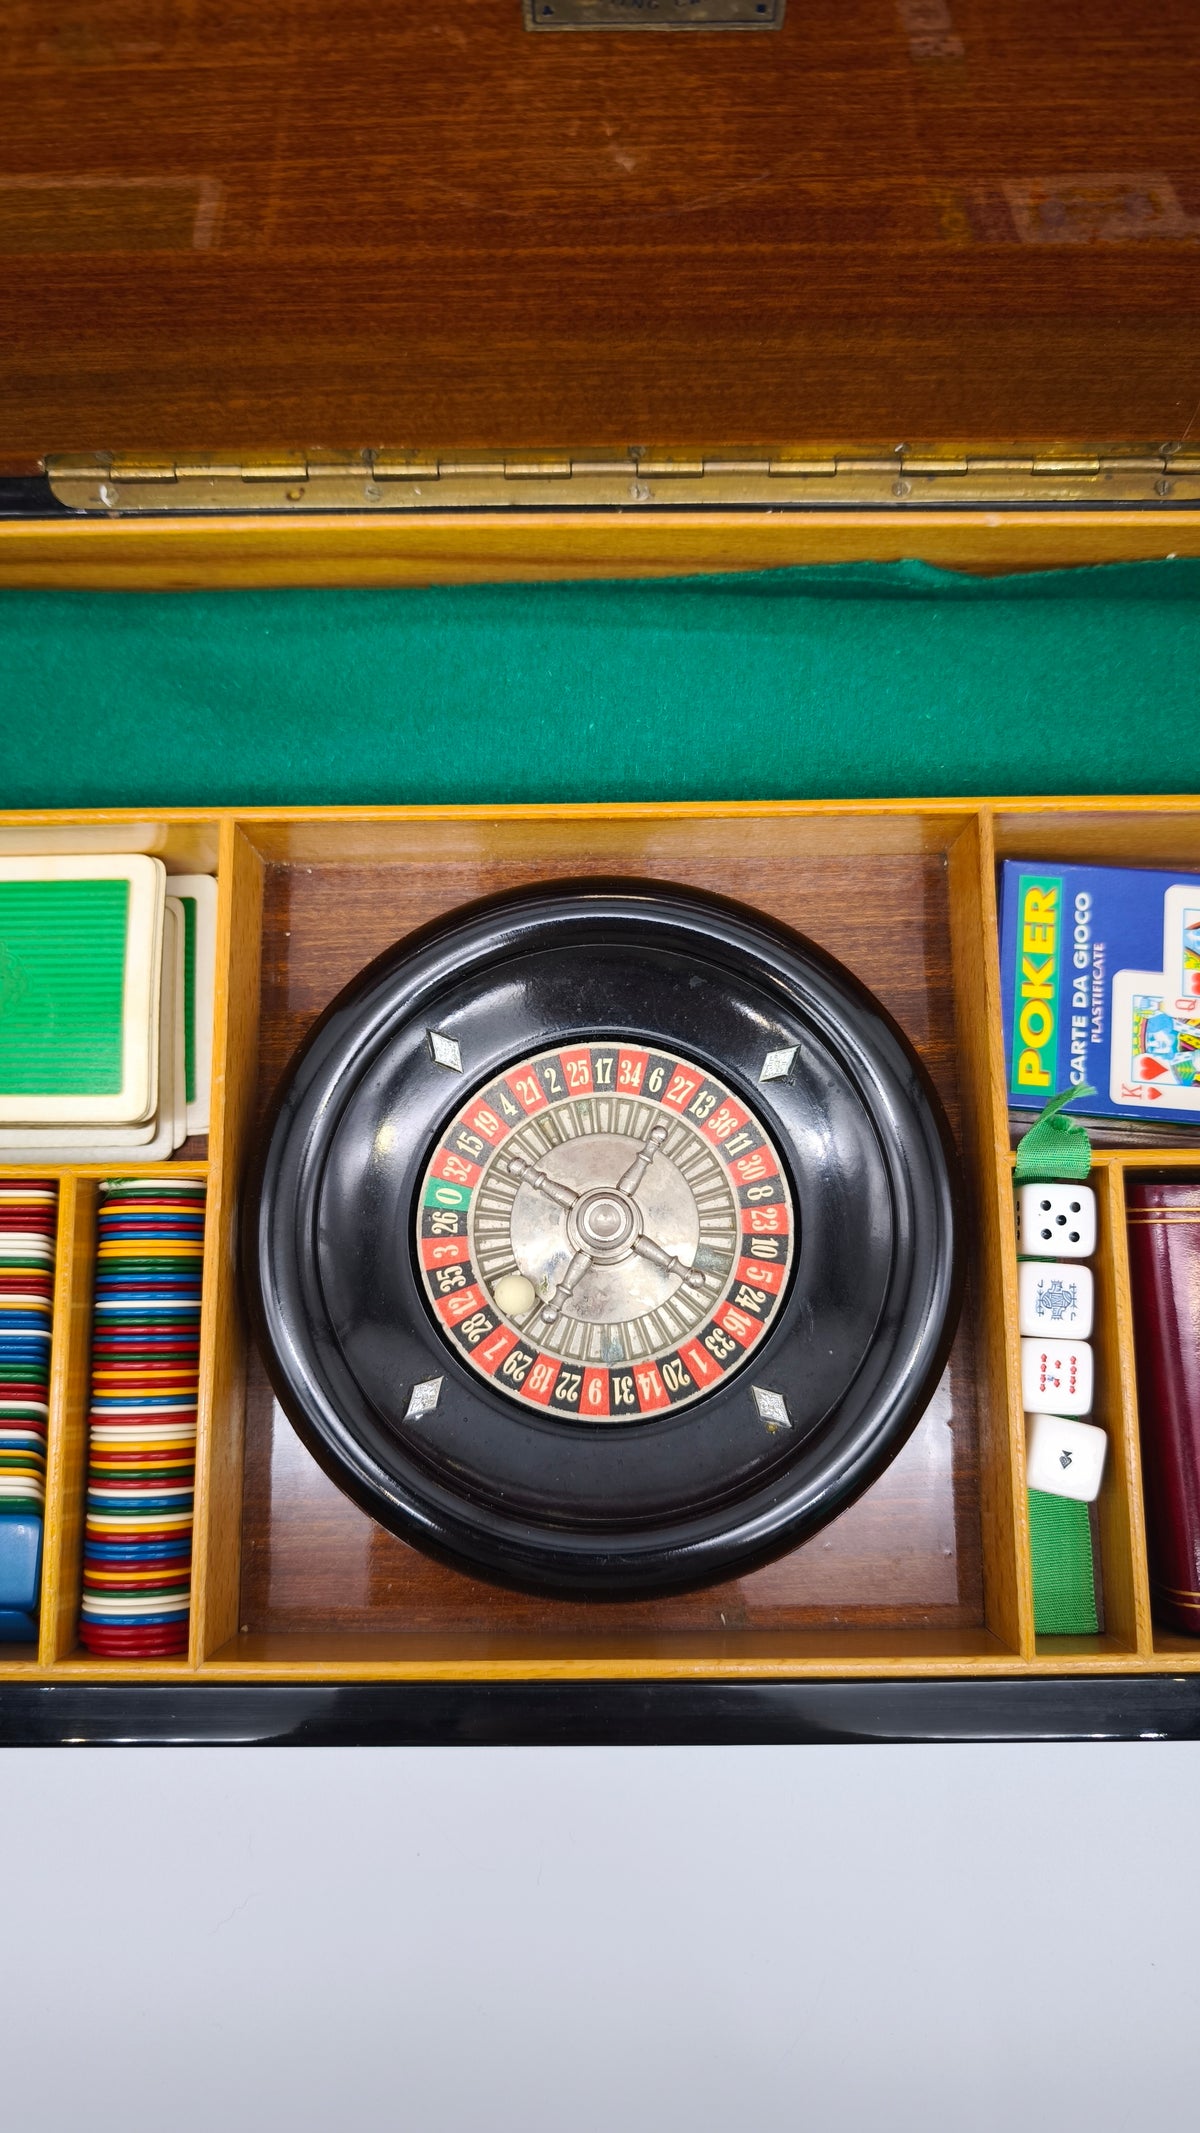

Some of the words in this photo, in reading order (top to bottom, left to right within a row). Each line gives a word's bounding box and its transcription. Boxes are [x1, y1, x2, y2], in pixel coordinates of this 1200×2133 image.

[1073, 892, 1092, 969] GIOCO
[1017, 887, 1057, 1087] POKER
[1072, 977, 1089, 1008] DA
[1091, 943, 1106, 1043] PLASTIFICATE
[1174, 998, 1197, 1012] Q
[1069, 1015, 1087, 1086] CARTE
[544, 1067, 562, 1094] 2
[566, 1059, 590, 1087] 25
[595, 1058, 613, 1084] 17
[619, 1060, 642, 1087] 34
[648, 1067, 664, 1093] 6
[516, 1076, 542, 1105] 21
[667, 1075, 695, 1104] 27
[1121, 1083, 1142, 1099] K
[499, 1093, 518, 1116] 4
[688, 1090, 716, 1119] 13
[473, 1110, 500, 1138] 19
[708, 1108, 738, 1138] 36
[456, 1131, 484, 1158] 15
[724, 1132, 753, 1157] 11
[442, 1157, 472, 1182] 32
[737, 1154, 767, 1180] 30
[435, 1187, 463, 1205] 0
[747, 1185, 774, 1200] 8
[431, 1211, 459, 1235] 26
[750, 1207, 779, 1232] 23
[433, 1244, 459, 1258] 3
[750, 1237, 779, 1259] 10
[436, 1265, 466, 1293] 35
[746, 1266, 773, 1284] 5
[448, 1290, 478, 1316] 12
[734, 1284, 767, 1313] 24
[461, 1312, 493, 1343] 28
[722, 1308, 751, 1337] 16
[483, 1337, 509, 1361] 7
[704, 1328, 736, 1359] 33
[503, 1350, 533, 1382] 29
[662, 1358, 691, 1392] 20
[688, 1349, 708, 1374] 1
[528, 1364, 555, 1393] 18
[555, 1371, 582, 1402] 22
[588, 1377, 602, 1405] 9
[612, 1376, 635, 1406] 31
[637, 1369, 662, 1401] 14
